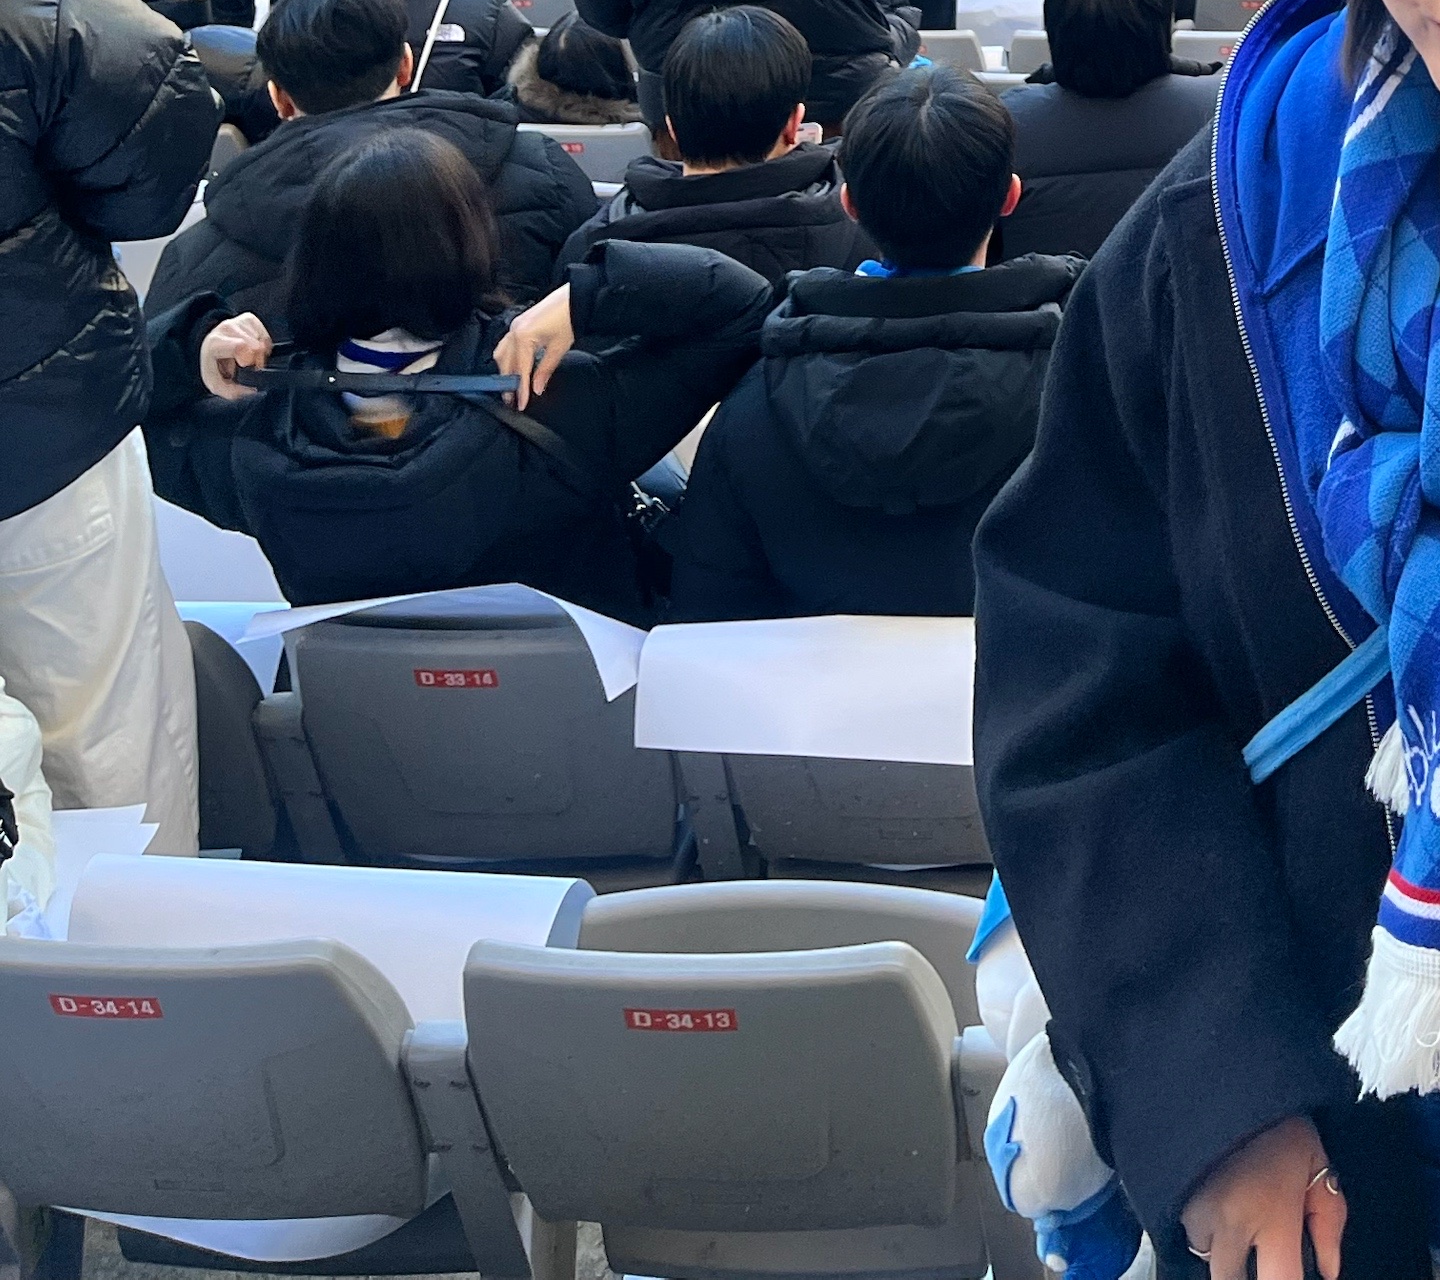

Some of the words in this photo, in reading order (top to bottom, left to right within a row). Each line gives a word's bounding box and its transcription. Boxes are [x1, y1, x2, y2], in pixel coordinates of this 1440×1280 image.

[420, 670, 493, 688] D-33-14
[58, 996, 155, 1016] D-34-14
[632, 1011, 731, 1029] D-34-13
